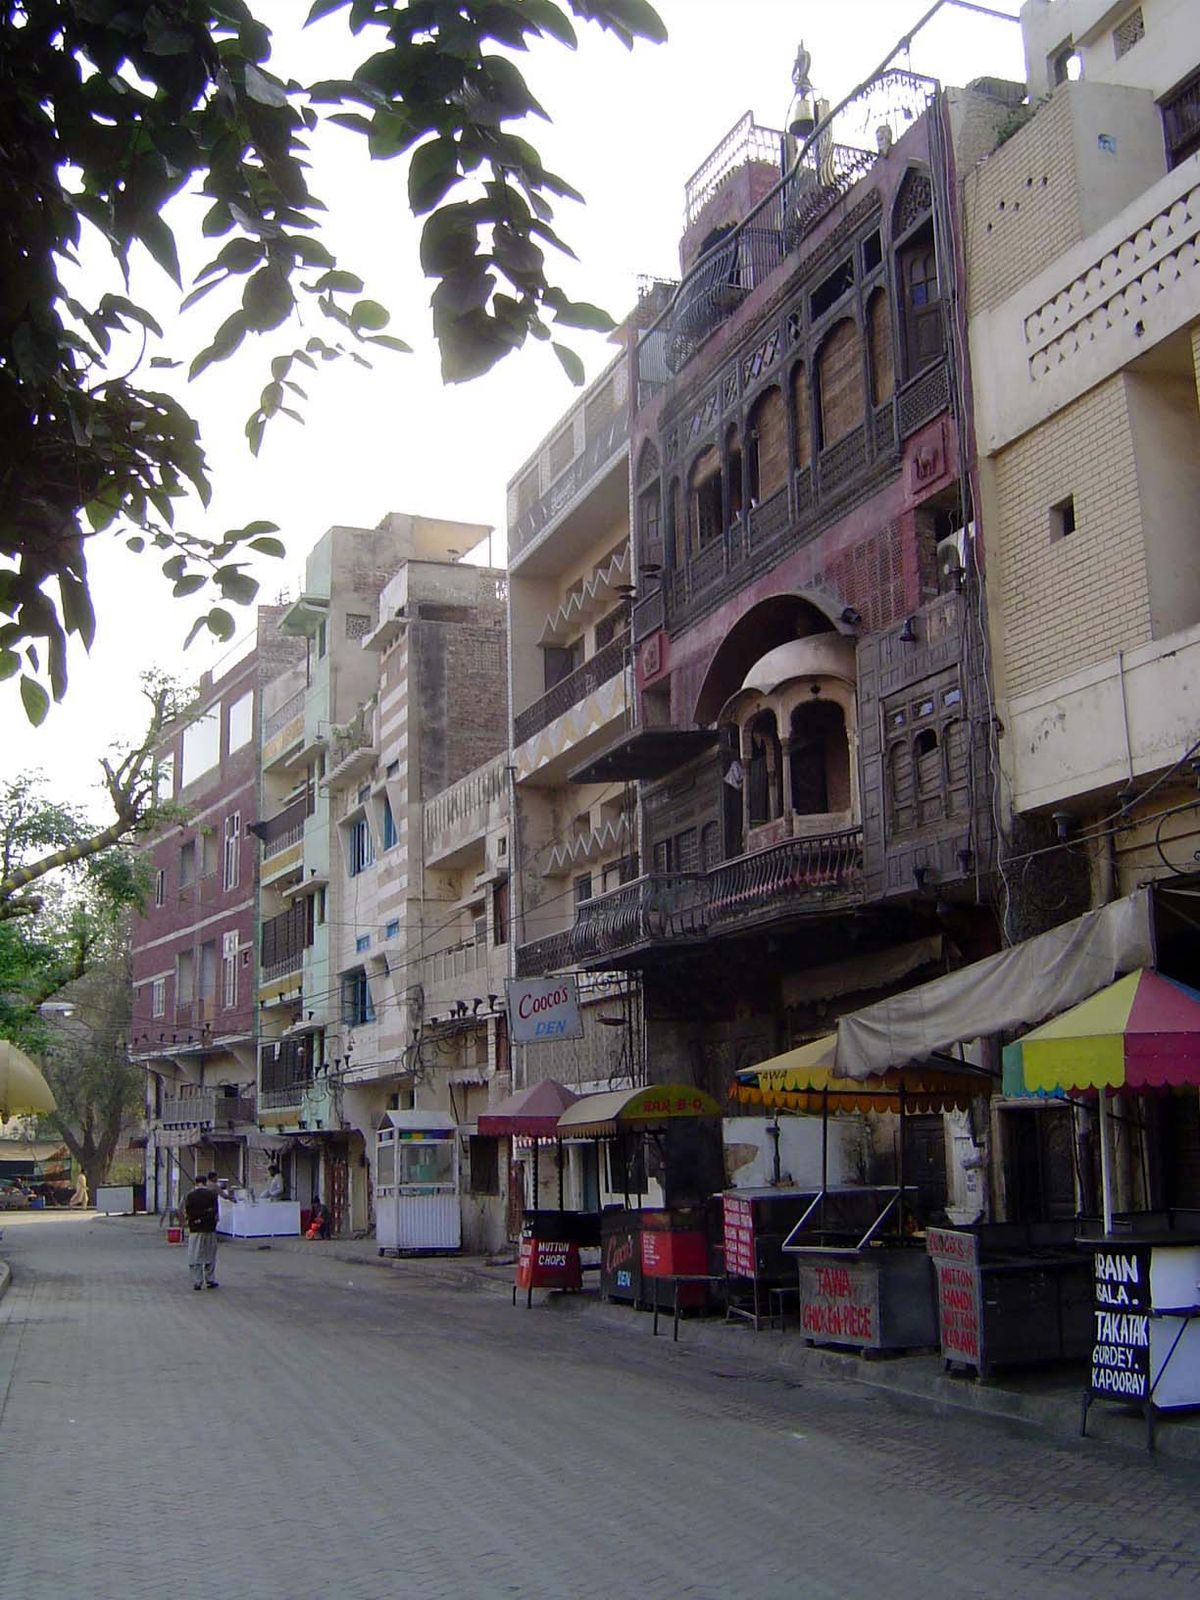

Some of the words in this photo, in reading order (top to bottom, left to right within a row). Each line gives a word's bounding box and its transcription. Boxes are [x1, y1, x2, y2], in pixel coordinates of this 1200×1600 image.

[535, 1020, 567, 1036] DEN
[538, 1241, 570, 1252] MUTTON
[538, 1254, 567, 1266] CHOPS
[815, 1265, 852, 1298] TAWA
[1094, 1310, 1149, 1346] TAKATAK
[1091, 1367, 1146, 1396] KAPOORAY
